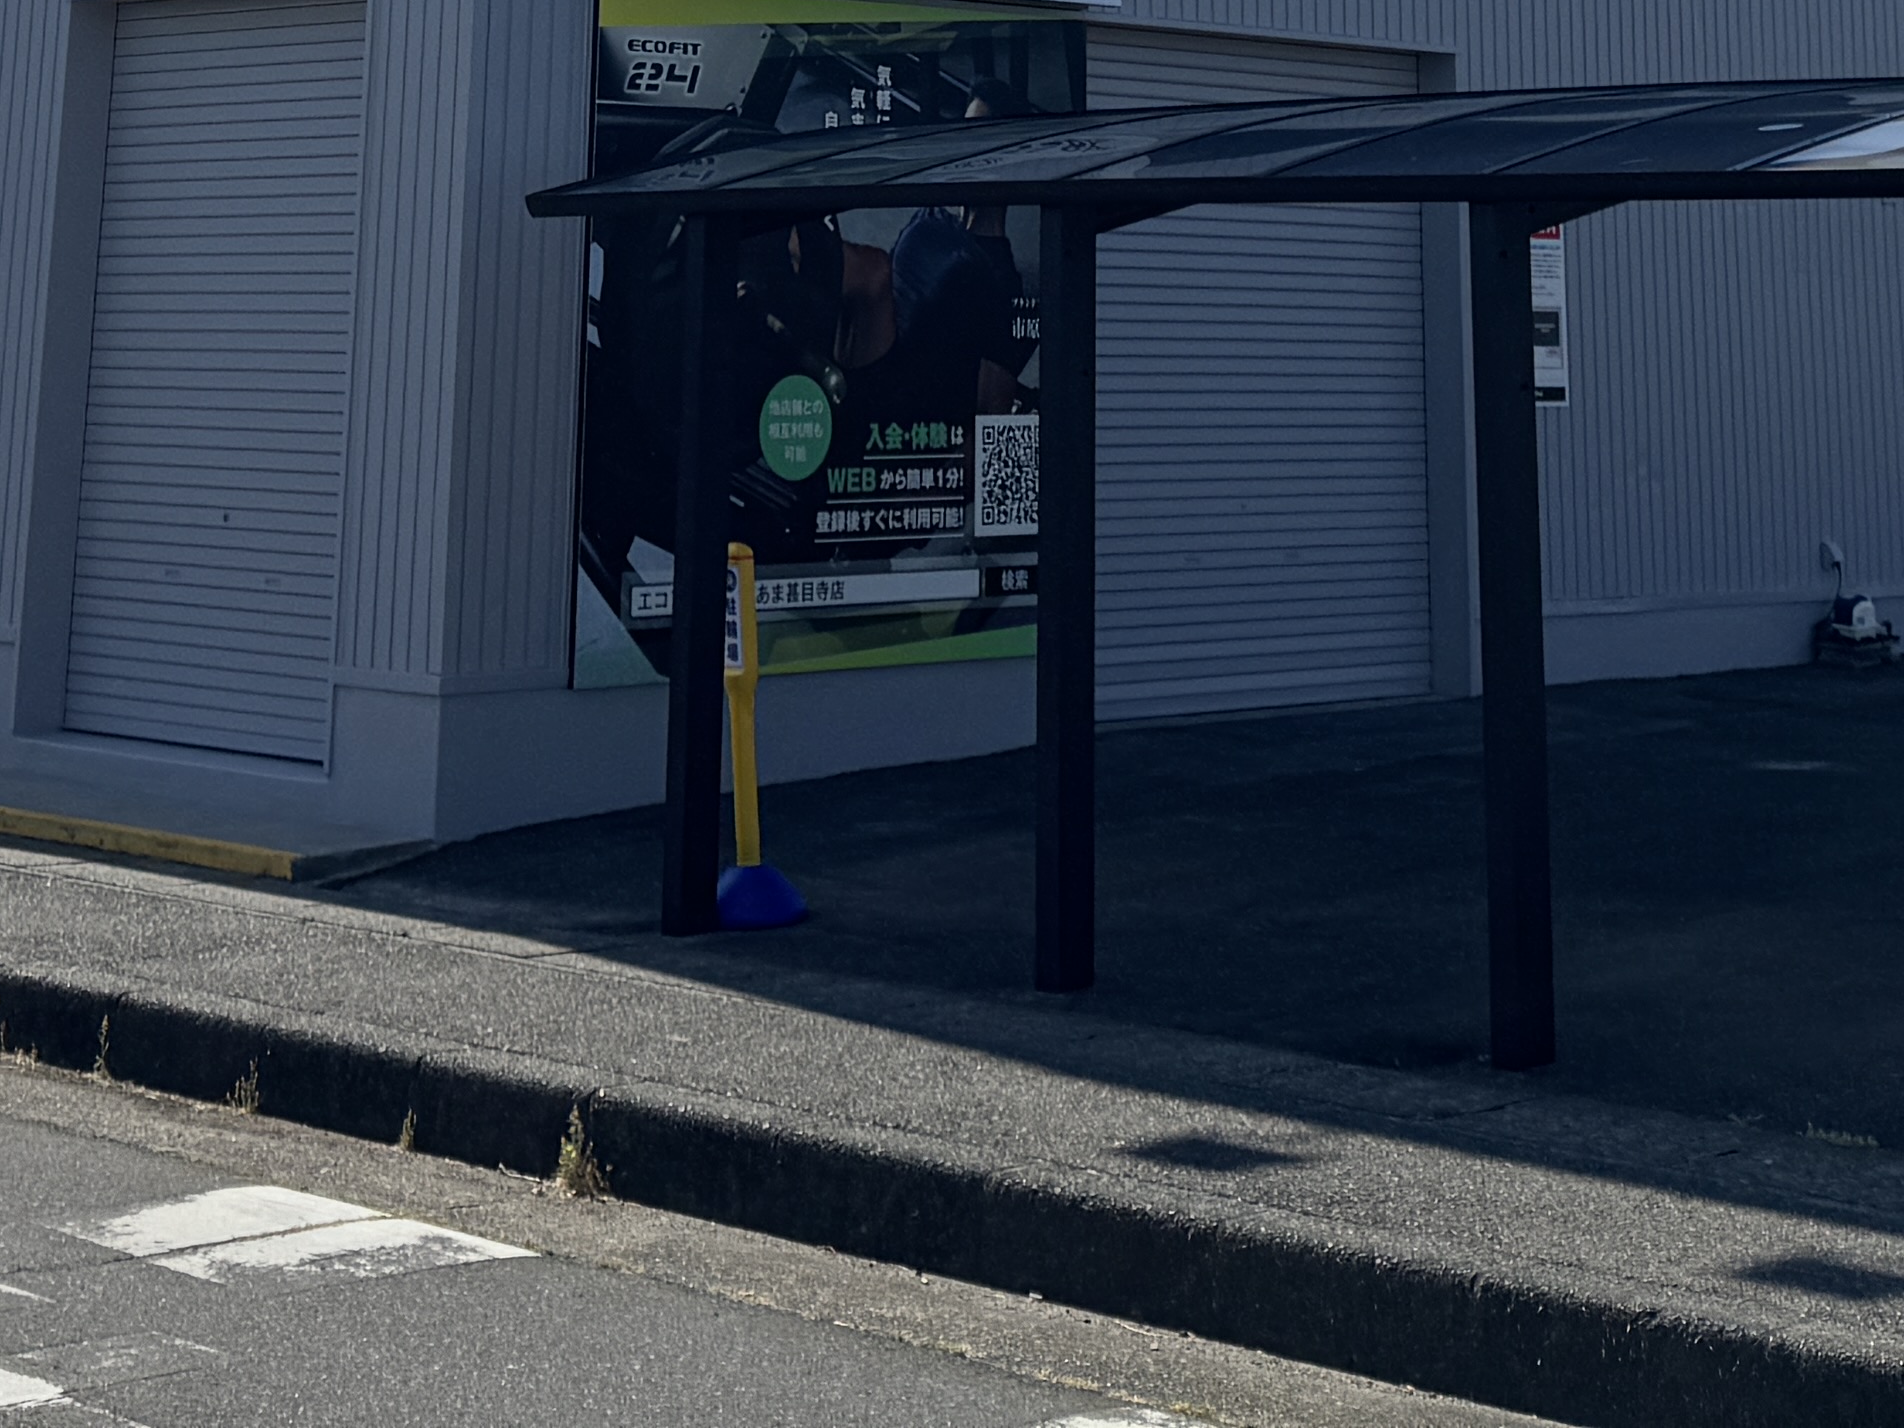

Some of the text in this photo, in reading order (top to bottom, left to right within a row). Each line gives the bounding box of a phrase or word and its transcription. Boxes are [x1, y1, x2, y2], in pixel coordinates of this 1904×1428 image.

[628, 39, 701, 55] ECOFIT
[627, 62, 700, 93] 24
[1002, 569, 1028, 591] 検索
